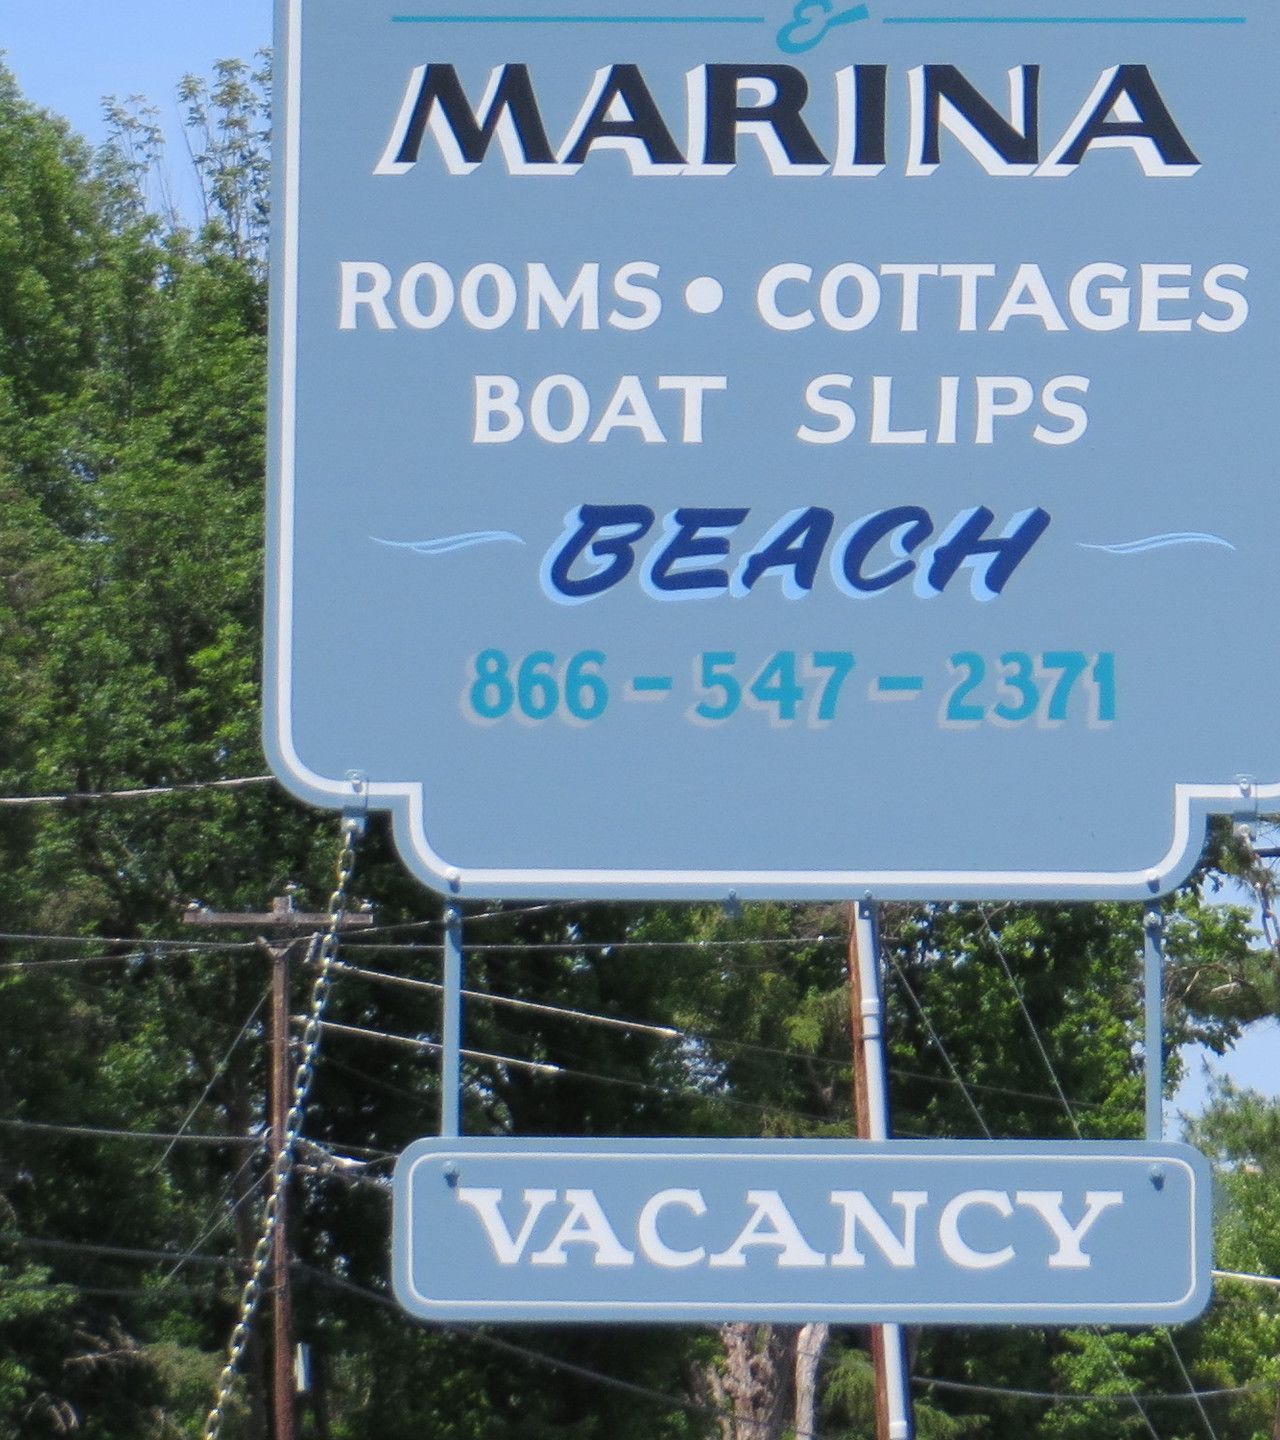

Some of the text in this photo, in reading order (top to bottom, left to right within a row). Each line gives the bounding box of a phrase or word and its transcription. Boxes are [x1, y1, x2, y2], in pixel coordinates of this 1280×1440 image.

[374, 63, 1203, 178] MARINA
[338, 261, 1250, 334] ROOMS COTTAGES
[472, 374, 1091, 445] BOAT SLIPS
[540, 504, 1051, 606] BEACH
[457, 1188, 1124, 1269] VACANCY
